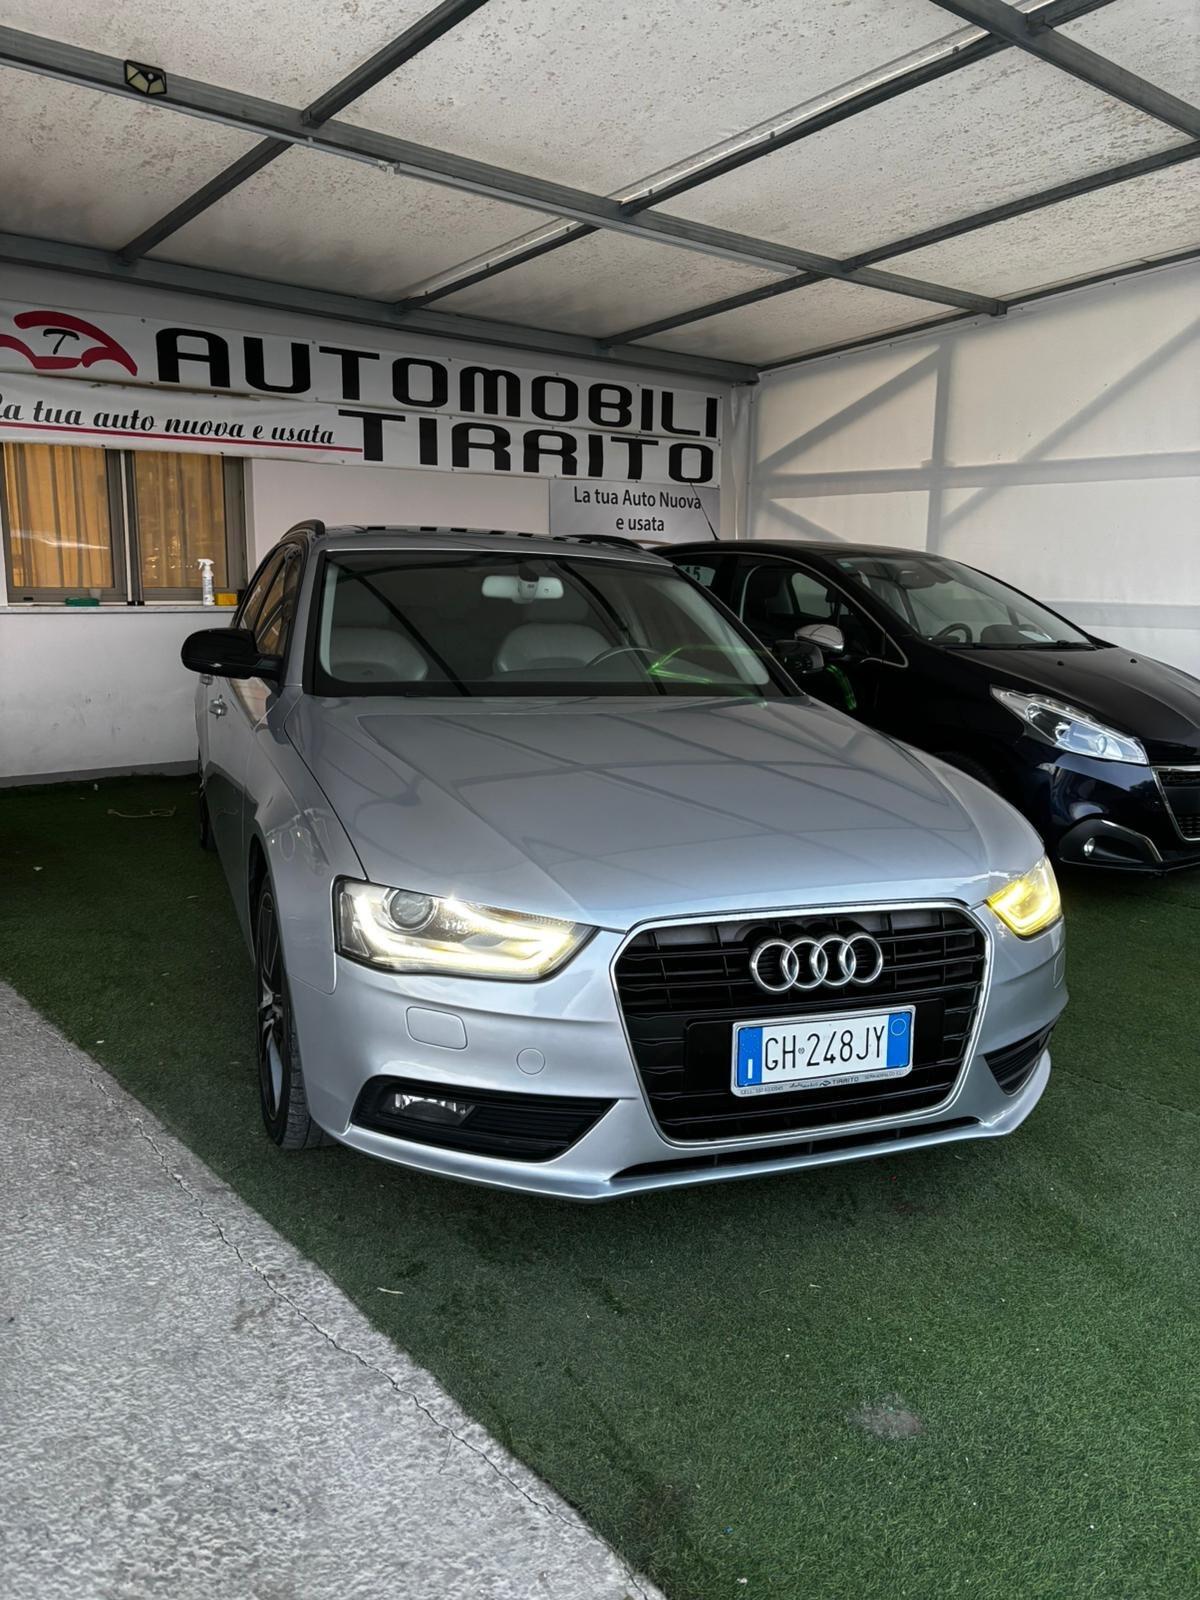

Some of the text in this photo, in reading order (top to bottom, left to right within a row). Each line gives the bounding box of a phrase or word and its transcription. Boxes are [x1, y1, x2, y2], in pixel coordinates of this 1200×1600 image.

[155, 327, 718, 438] AUTOMOBILI
[33, 400, 85, 425] tua
[93, 409, 157, 431] auto
[164, 418, 245, 438] nuova
[252, 424, 264, 439] e
[271, 424, 335, 444] usata
[338, 409, 714, 484] TIRRITO
[574, 486, 701, 509] La tua Auto Nuova
[616, 516, 665, 531] e usata
